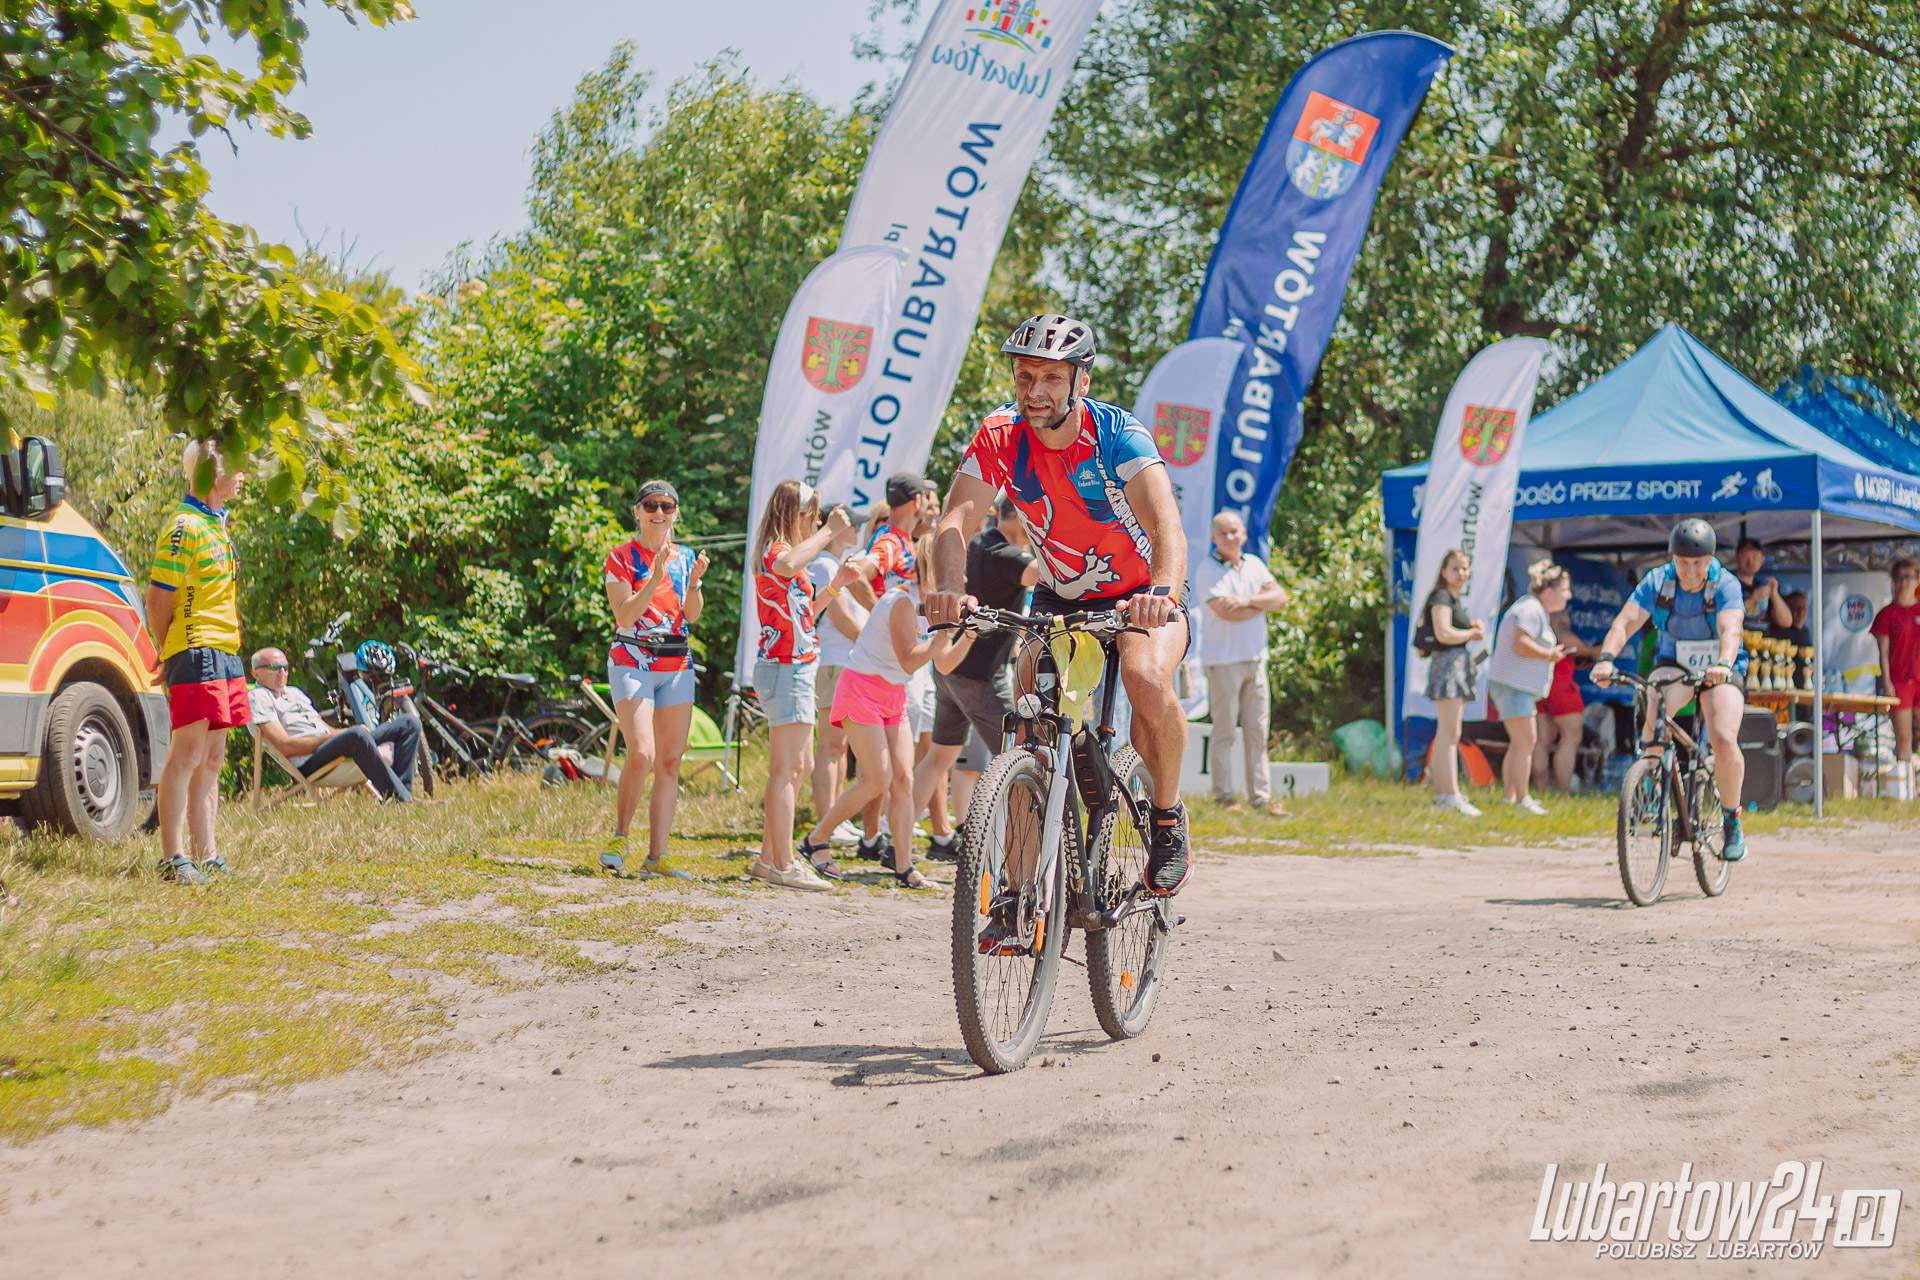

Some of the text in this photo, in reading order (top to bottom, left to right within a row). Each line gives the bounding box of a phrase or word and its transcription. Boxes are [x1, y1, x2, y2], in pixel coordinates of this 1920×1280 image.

[803, 408, 832, 489] artów
[1570, 481, 1632, 503] PRZEZ
[1636, 479, 1702, 501] SPORT
[1460, 480, 1484, 597] Lartów
